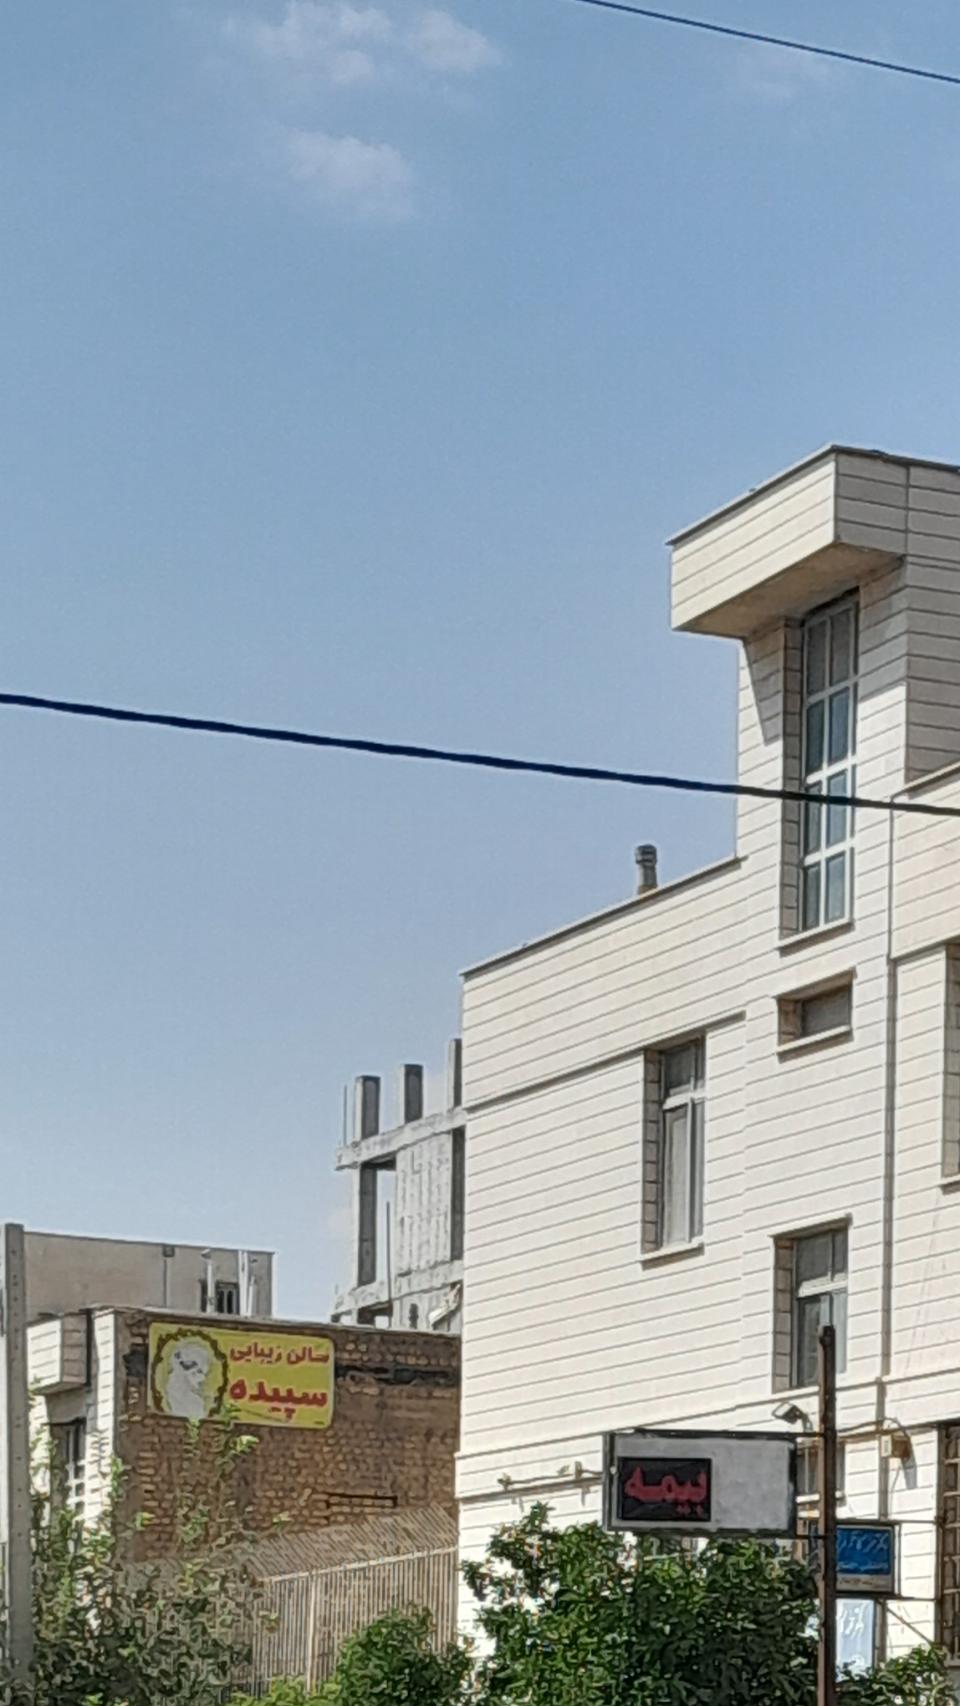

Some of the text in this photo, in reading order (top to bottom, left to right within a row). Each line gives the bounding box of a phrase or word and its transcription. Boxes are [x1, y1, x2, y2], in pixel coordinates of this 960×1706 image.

[229, 1342, 330, 1365] سالن زیبایی
[229, 1378, 328, 1420] سپیده
[624, 1466, 707, 1518] بیمه
